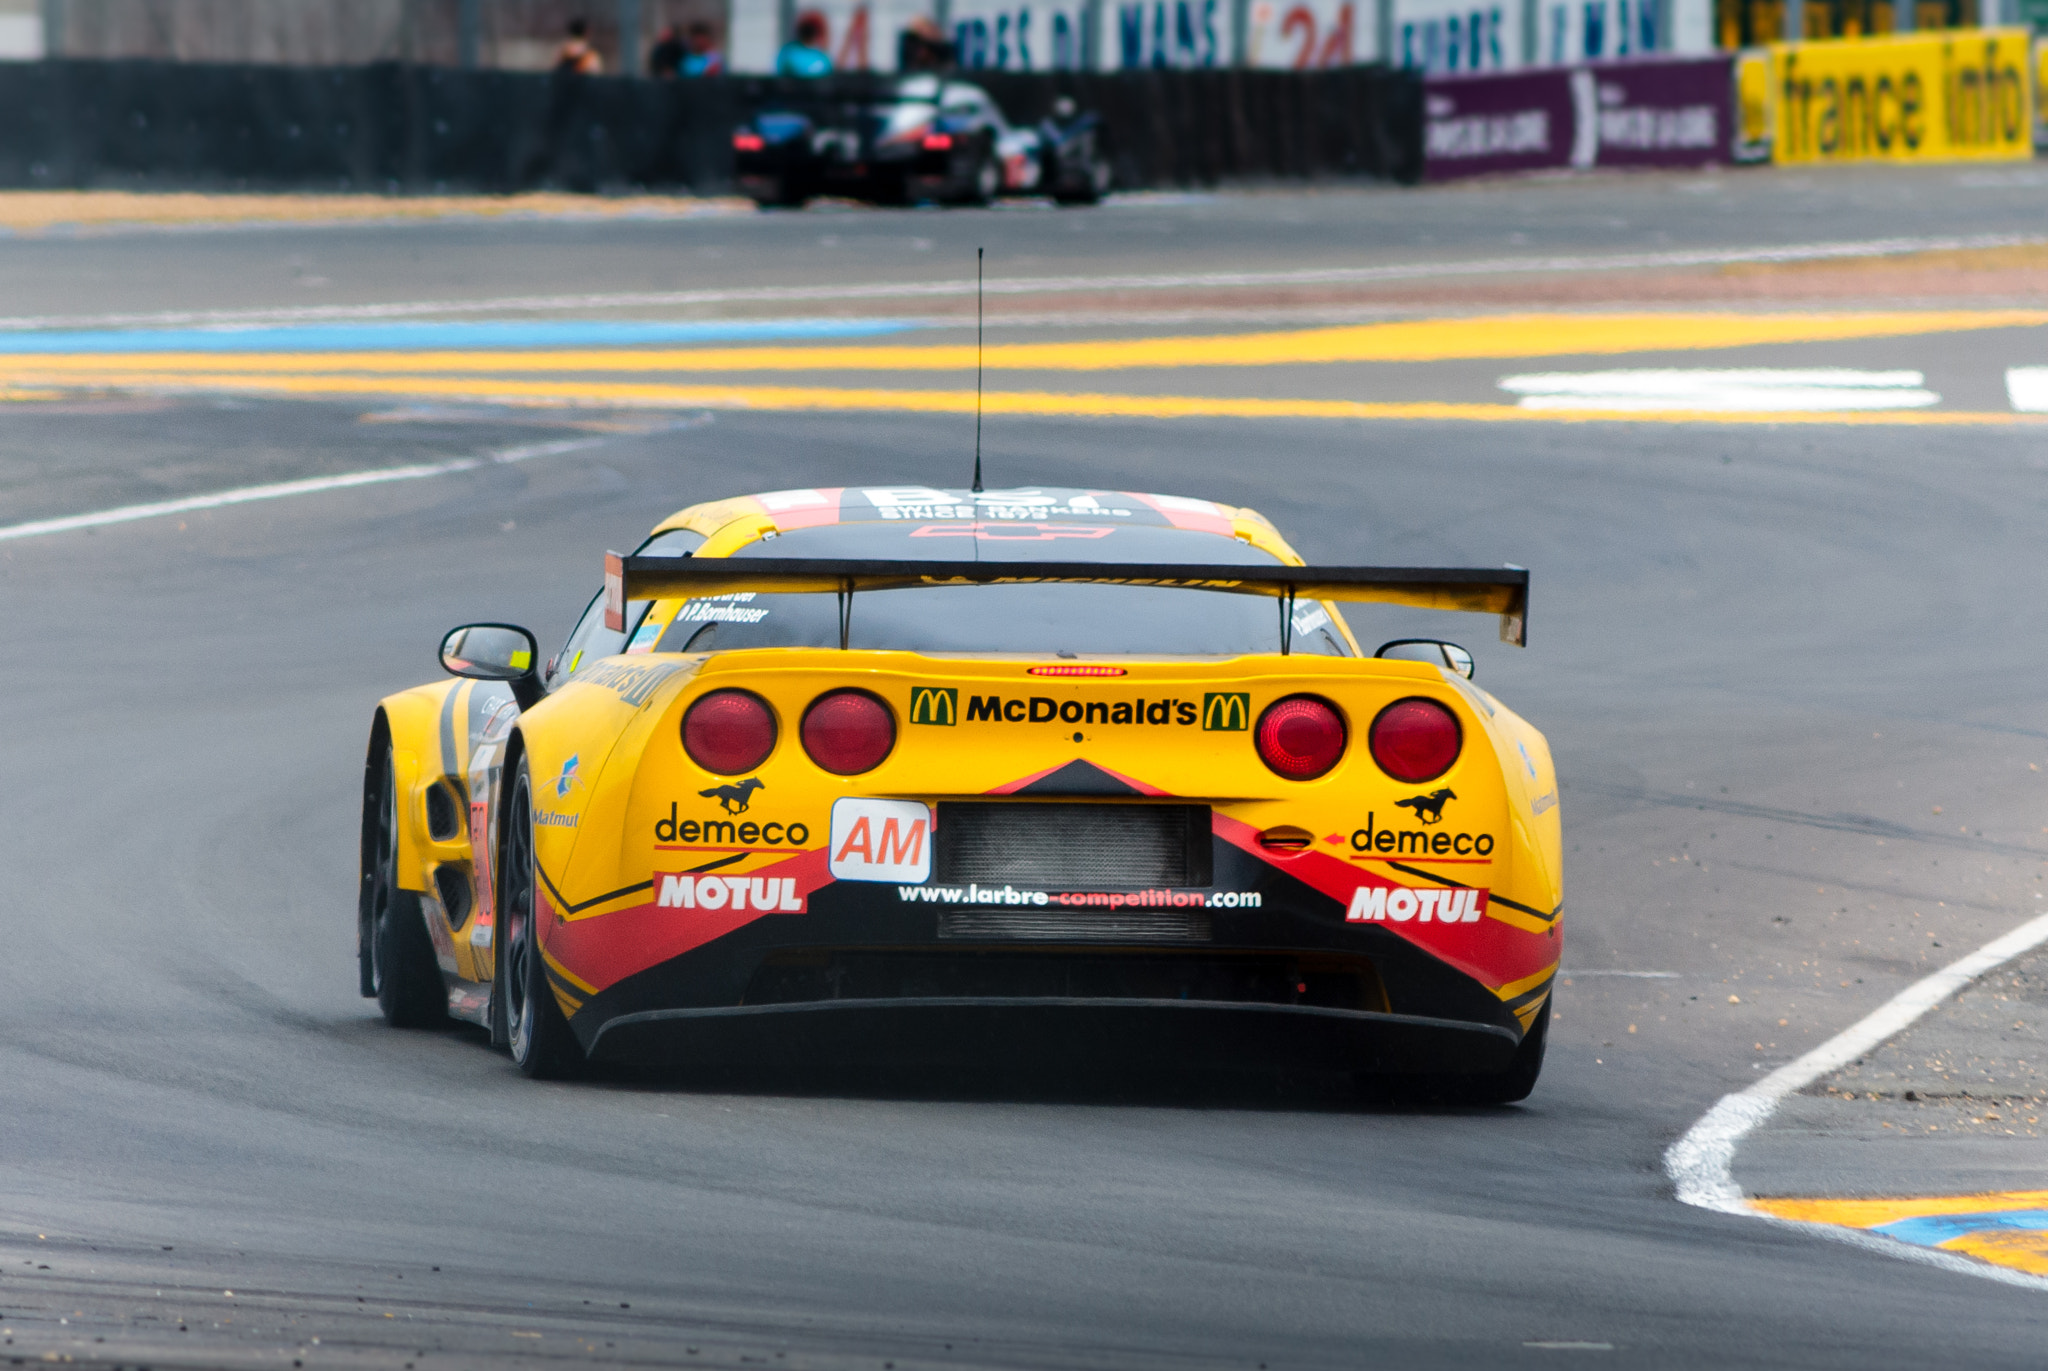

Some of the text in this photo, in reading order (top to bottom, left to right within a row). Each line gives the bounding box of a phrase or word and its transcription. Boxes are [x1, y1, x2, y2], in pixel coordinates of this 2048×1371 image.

[1783, 51, 1924, 156] france
[1942, 37, 2023, 149] info
[966, 696, 1197, 726] McDonald's
[533, 809, 579, 828] Matmut
[655, 802, 809, 845] demeco
[1351, 811, 1494, 856] demeco
[834, 816, 927, 866] AM
[657, 875, 803, 911] MOTUL
[898, 884, 1262, 911] www.larbre-competition.com
[1347, 886, 1482, 923] MOTUL
